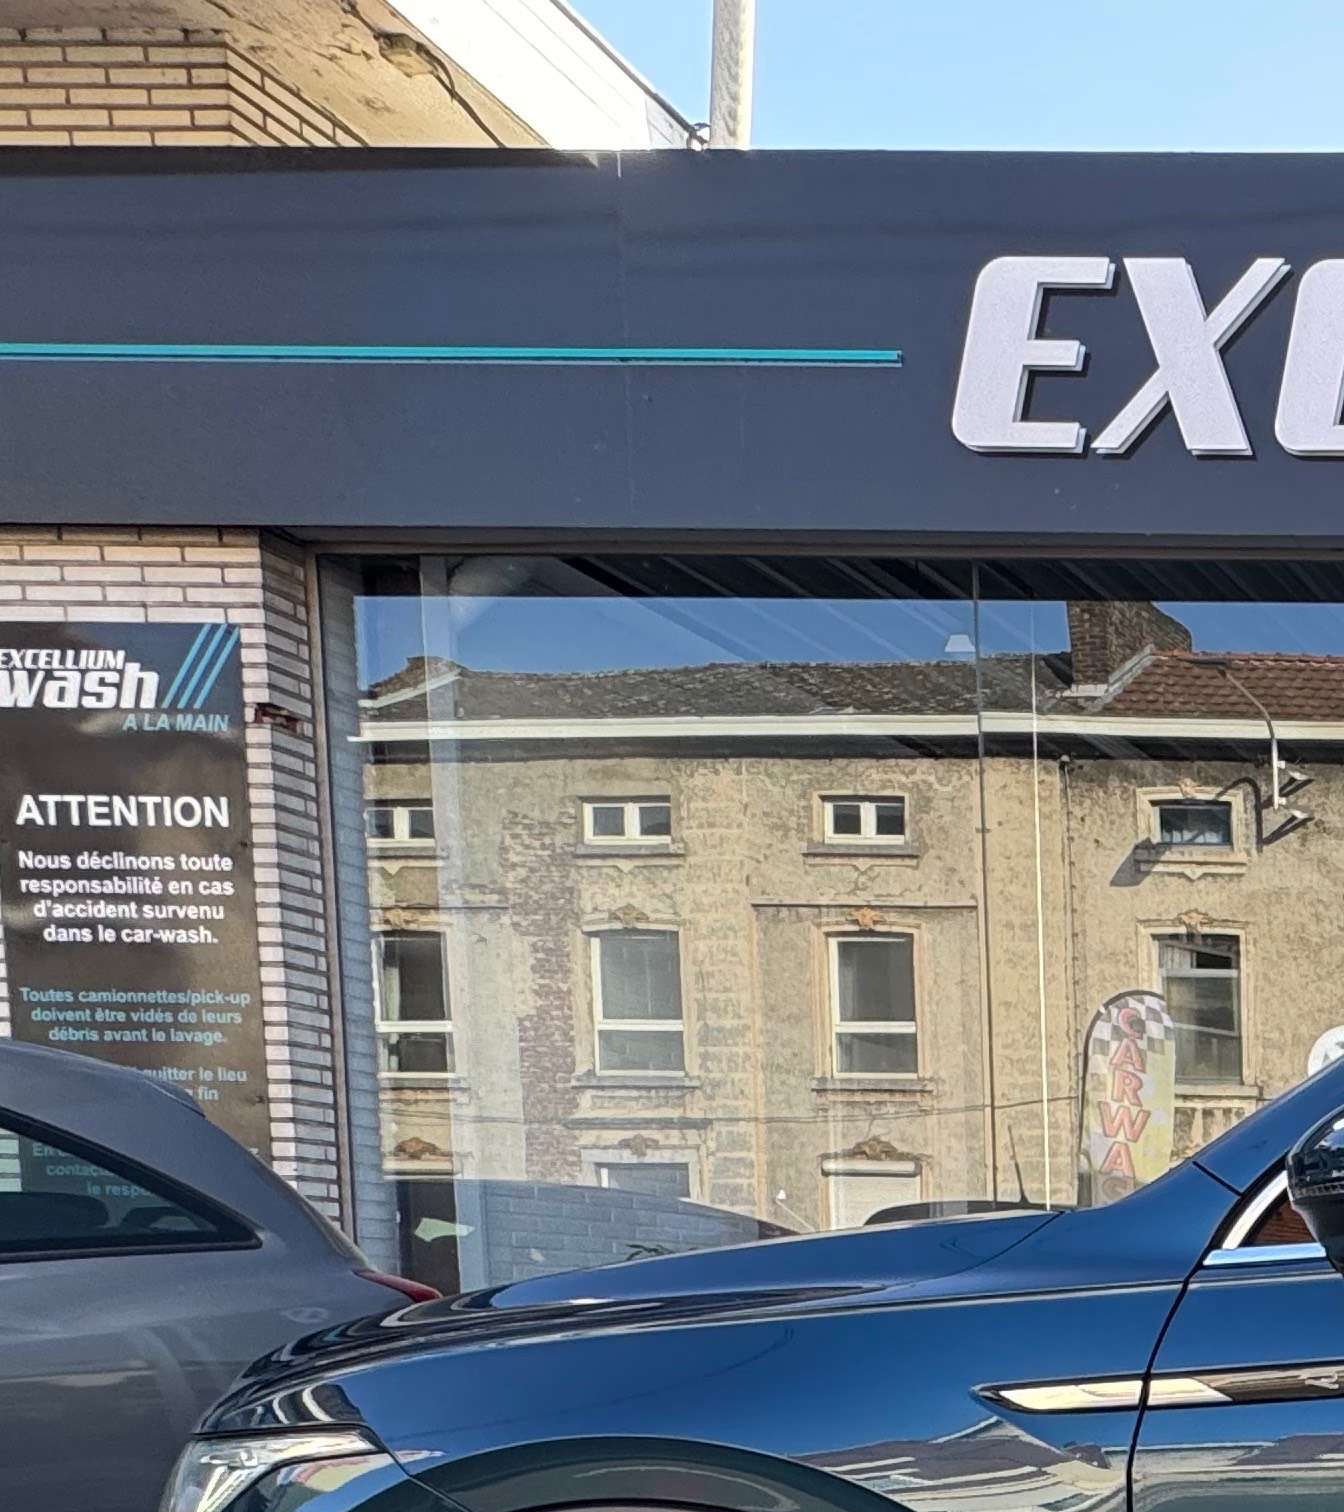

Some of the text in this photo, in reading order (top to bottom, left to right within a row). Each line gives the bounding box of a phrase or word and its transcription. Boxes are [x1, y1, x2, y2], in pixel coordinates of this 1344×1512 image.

[122, 713, 229, 732] A LA MAIN
[15, 794, 230, 828] ATTENTION
[18, 850, 234, 872] Nous déclinons toute
[20, 875, 235, 897] responsabilité en cas
[33, 900, 225, 920] d'accident survenu
[43, 925, 219, 944] dans le car-wash.
[19, 987, 250, 1007] Toutes camionnettes/pick-up
[31, 1007, 91, 1022] doivent
[177, 1009, 197, 1024] de
[201, 1009, 242, 1025] leurs
[49, 1027, 98, 1042] débris
[104, 1029, 148, 1043] avant
[152, 1028, 167, 1043] le
[200, 1066, 214, 1082] le
[219, 1066, 248, 1082] lieu
[198, 1086, 219, 1101] fin
